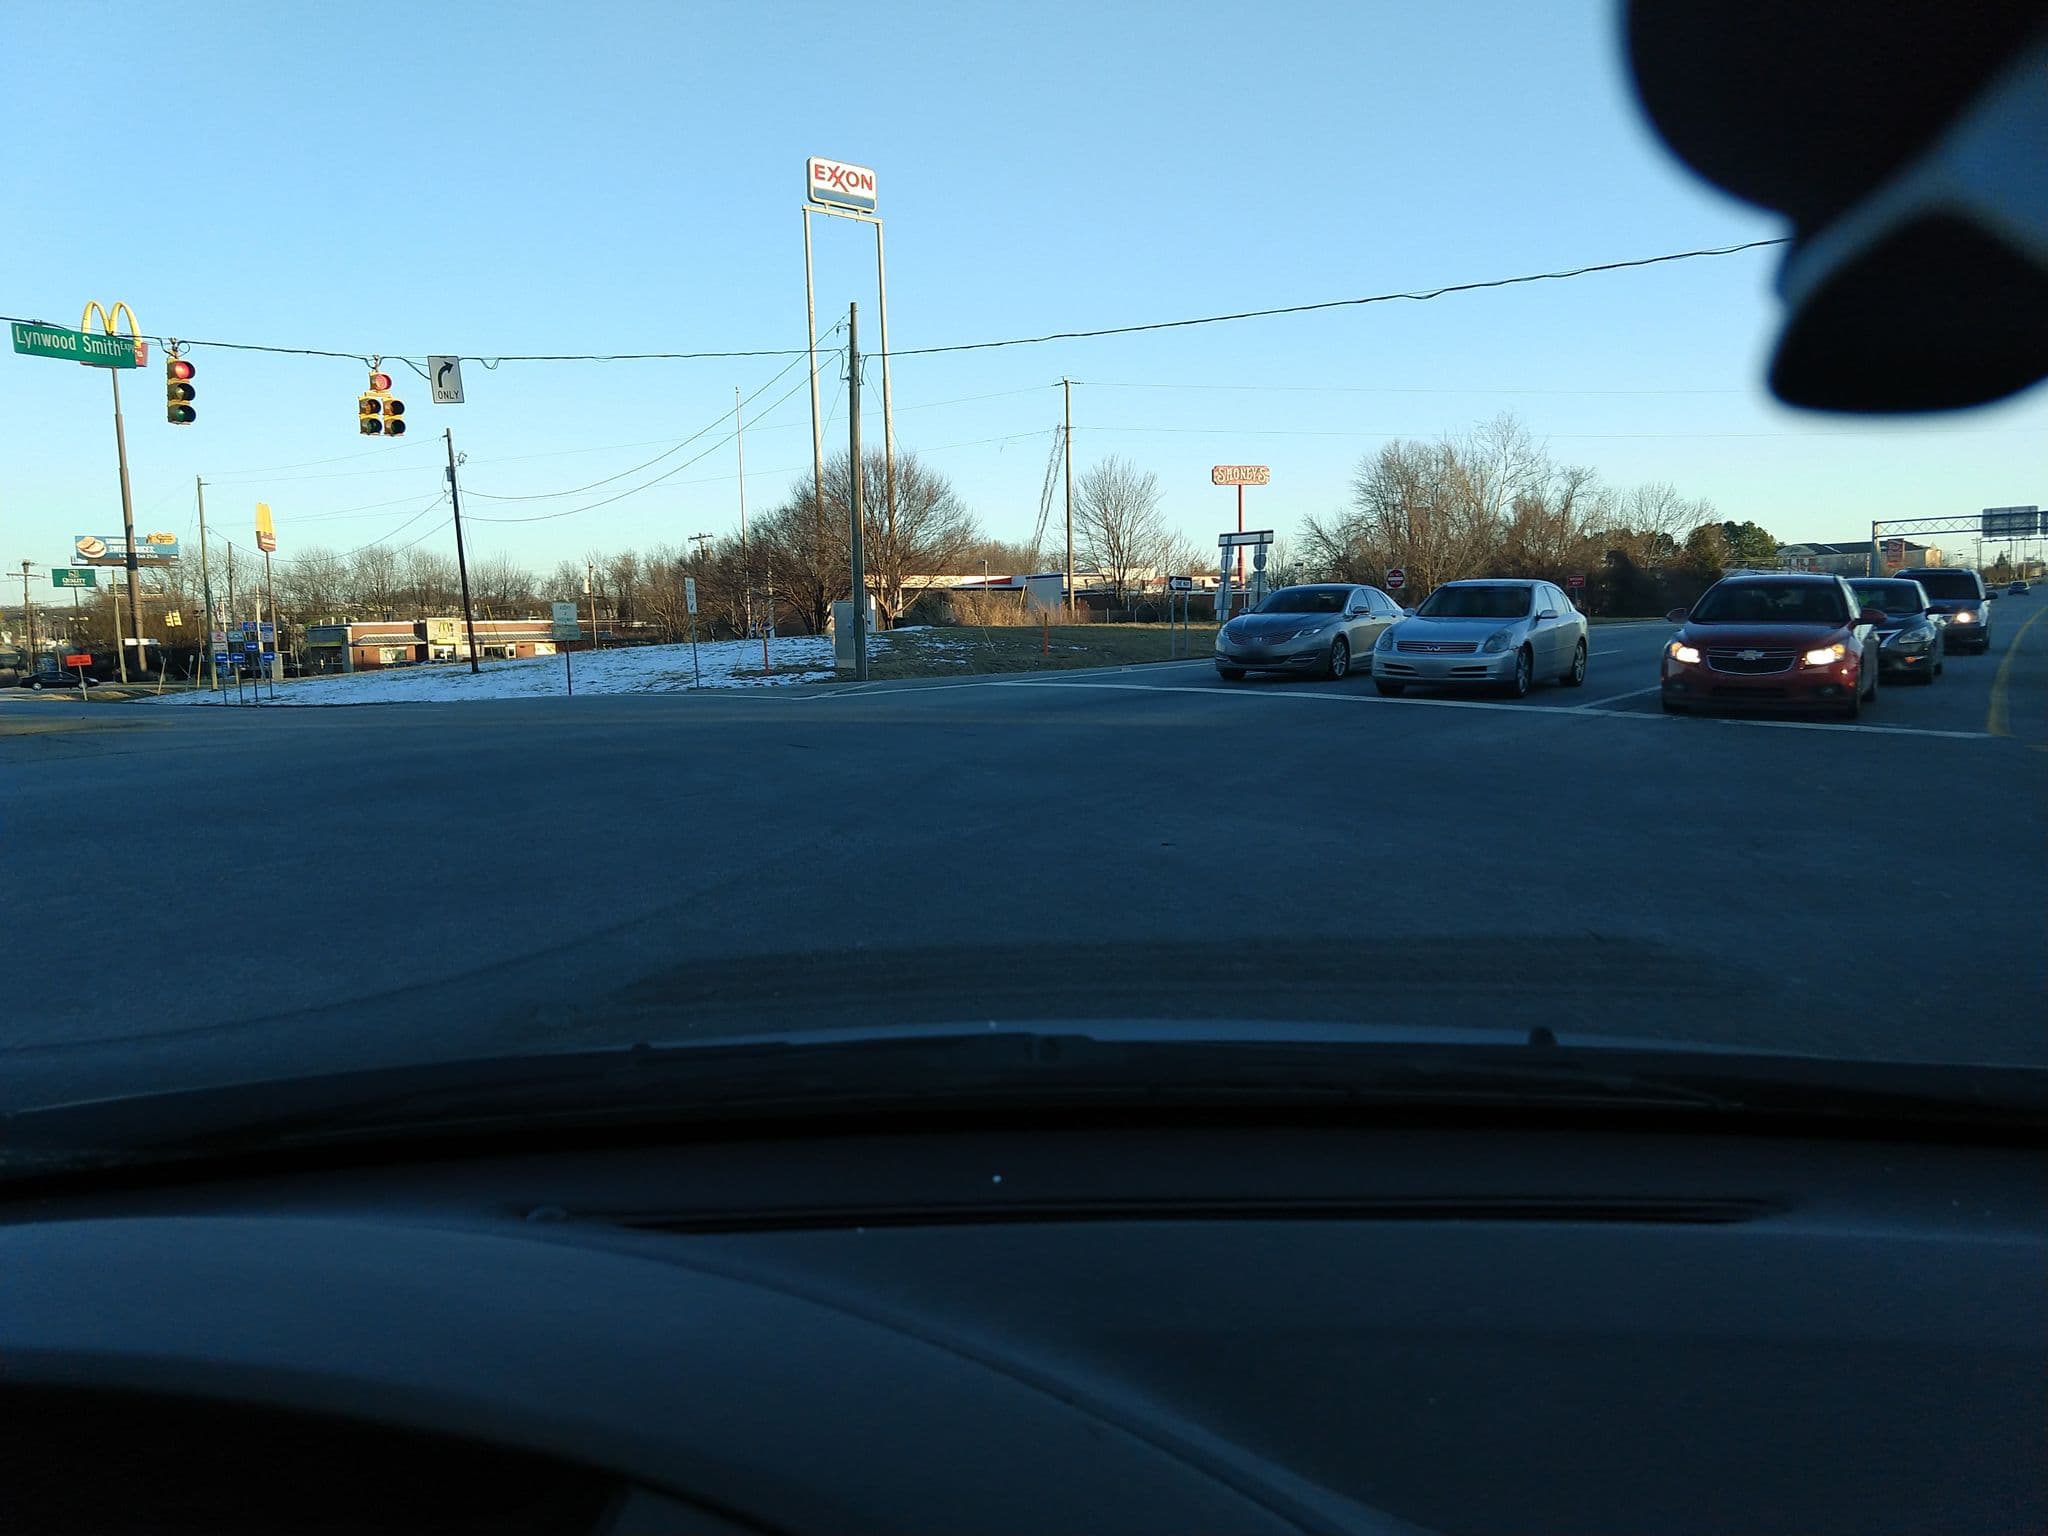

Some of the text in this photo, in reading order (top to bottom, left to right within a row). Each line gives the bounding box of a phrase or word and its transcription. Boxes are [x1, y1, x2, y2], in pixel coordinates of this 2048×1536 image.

[814, 163, 873, 192] EXXON
[15, 325, 77, 350] Lynwood
[82, 335, 122, 357] Smith
[437, 389, 460, 400] ONLY
